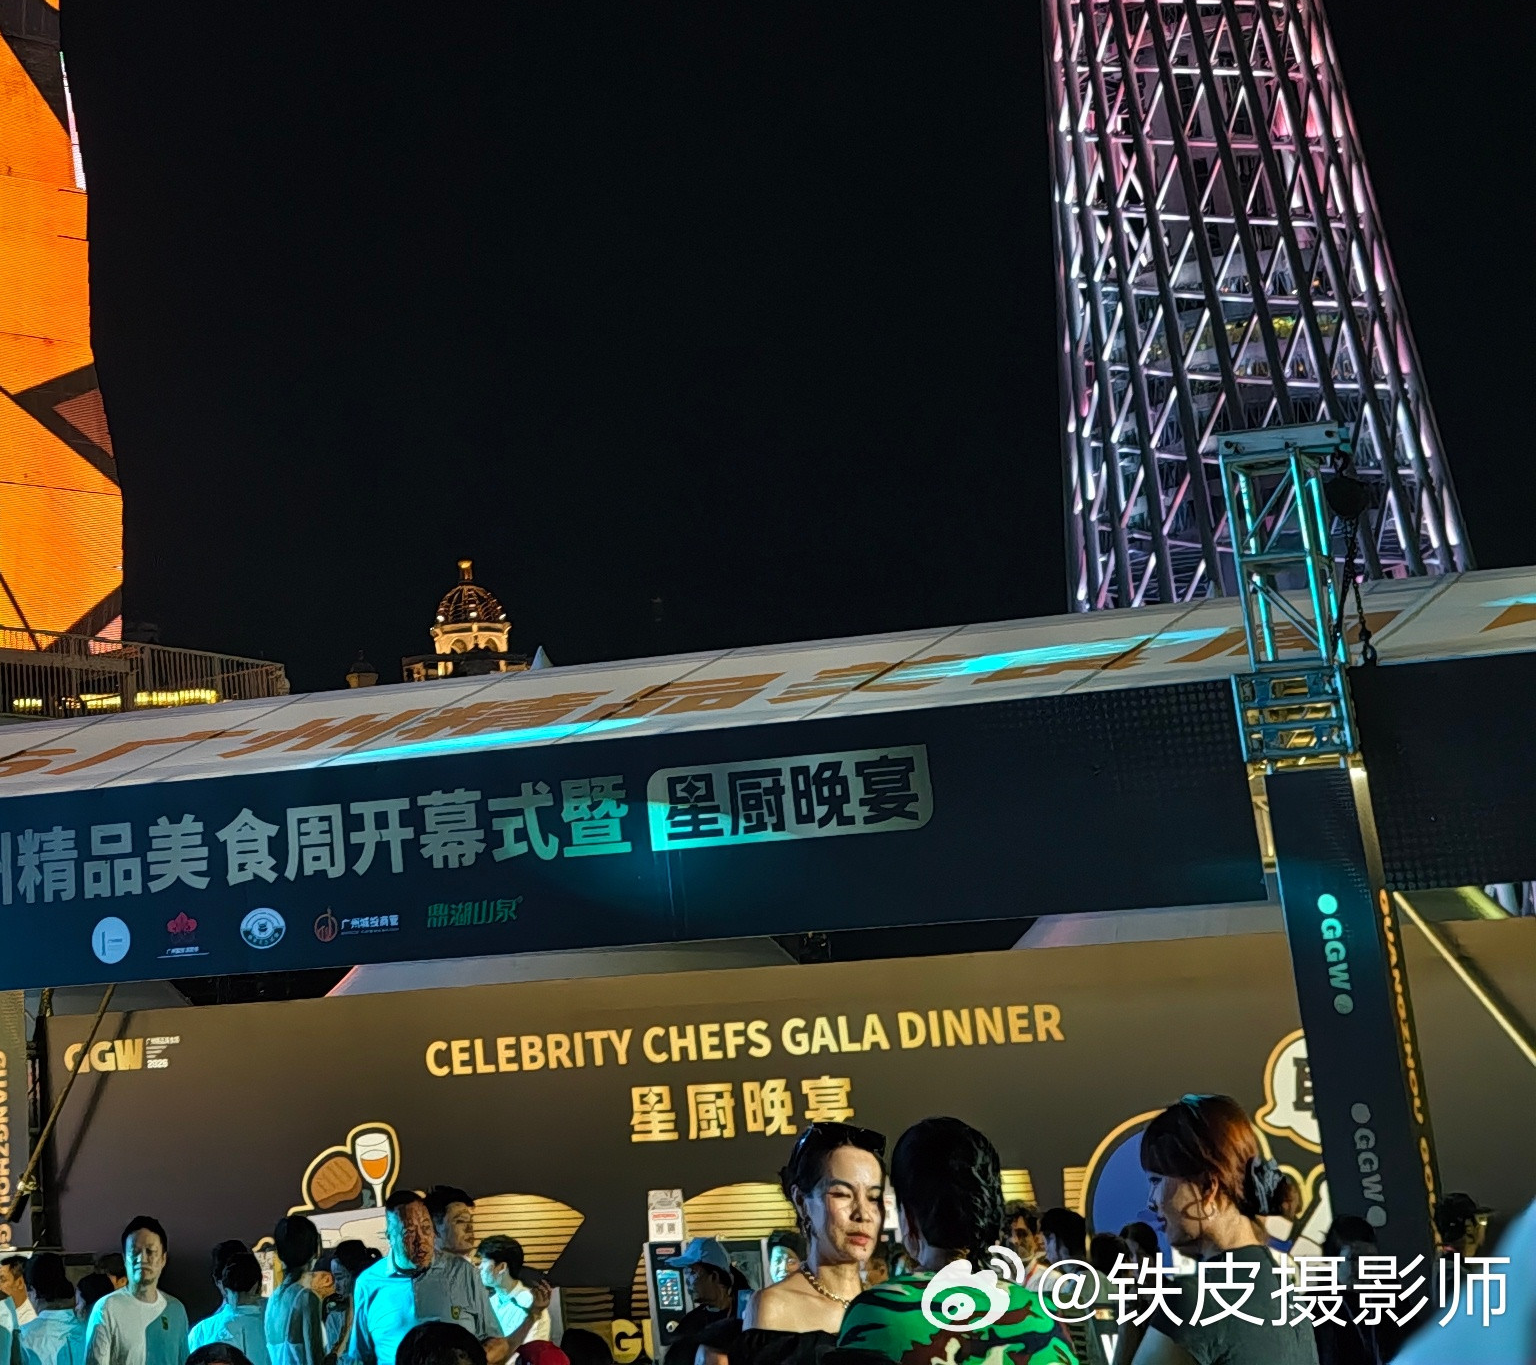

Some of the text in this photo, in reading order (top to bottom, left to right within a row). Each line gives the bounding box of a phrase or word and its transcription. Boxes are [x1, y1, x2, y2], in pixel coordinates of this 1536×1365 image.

[665, 754, 920, 841] 星厨晚宴
[1321, 918, 1352, 991] GGW
[64, 1038, 144, 1073] GGW
[425, 1004, 1065, 1077] CELEBRITY CHEFS GALA DINNER
[630, 1075, 856, 1143] 星厨晚宴
[1353, 1127, 1386, 1204] GGW
